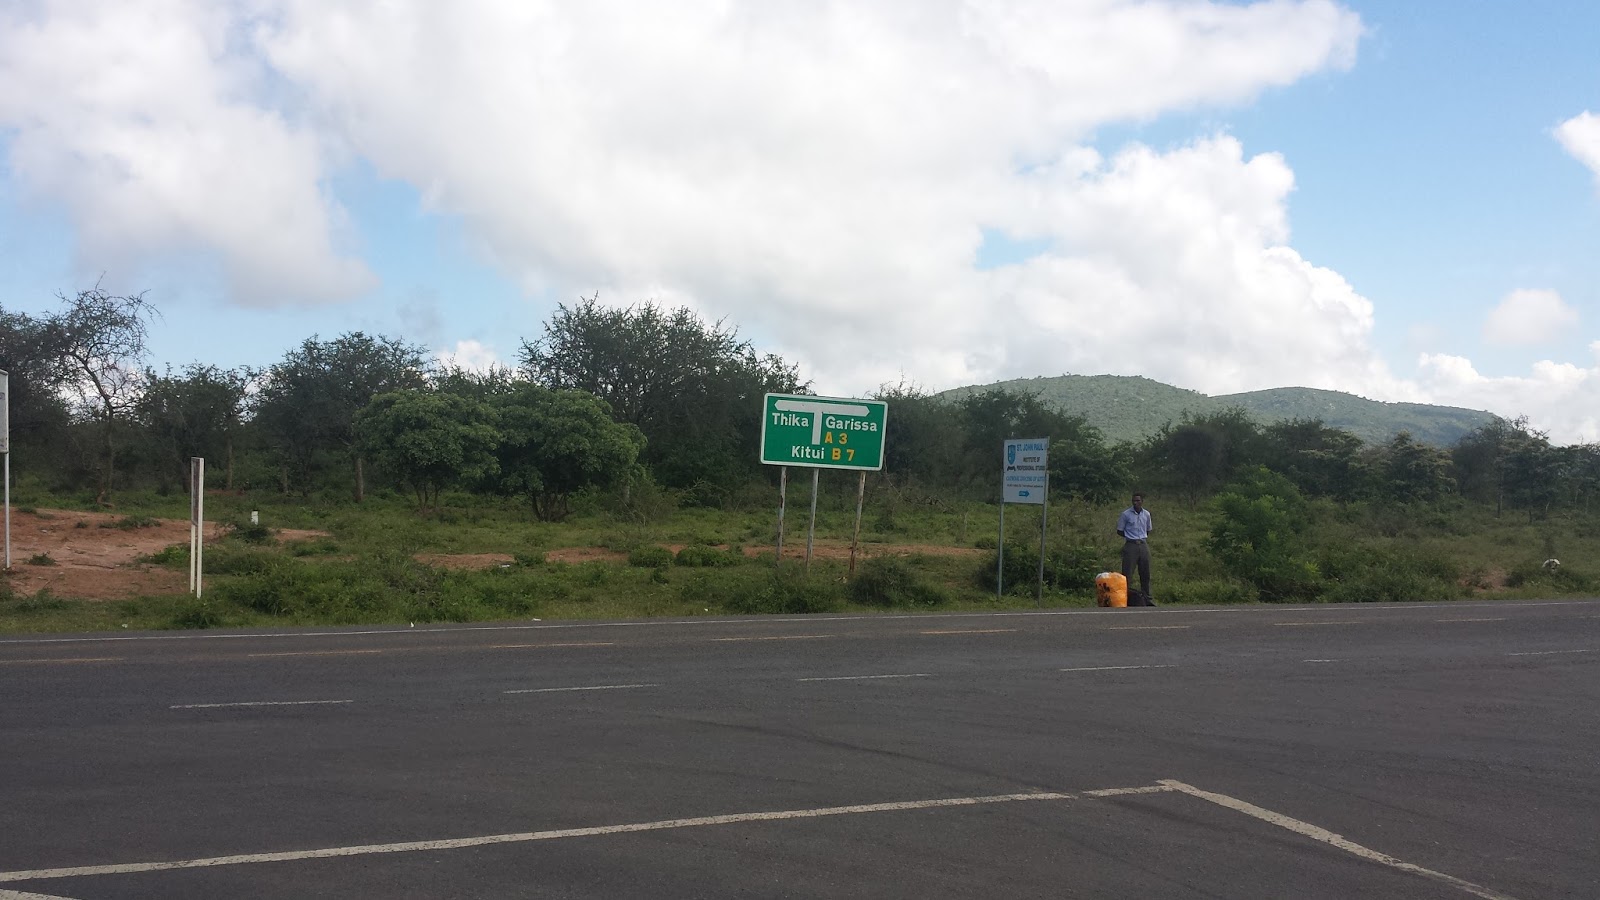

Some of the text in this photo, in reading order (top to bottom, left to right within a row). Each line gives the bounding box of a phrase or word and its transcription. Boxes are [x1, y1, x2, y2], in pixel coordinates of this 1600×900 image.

[772, 412, 809, 427] Thika
[825, 416, 877, 432] Garissa
[824, 431, 848, 445] A 3
[791, 445, 855, 461] Kitui B 7
